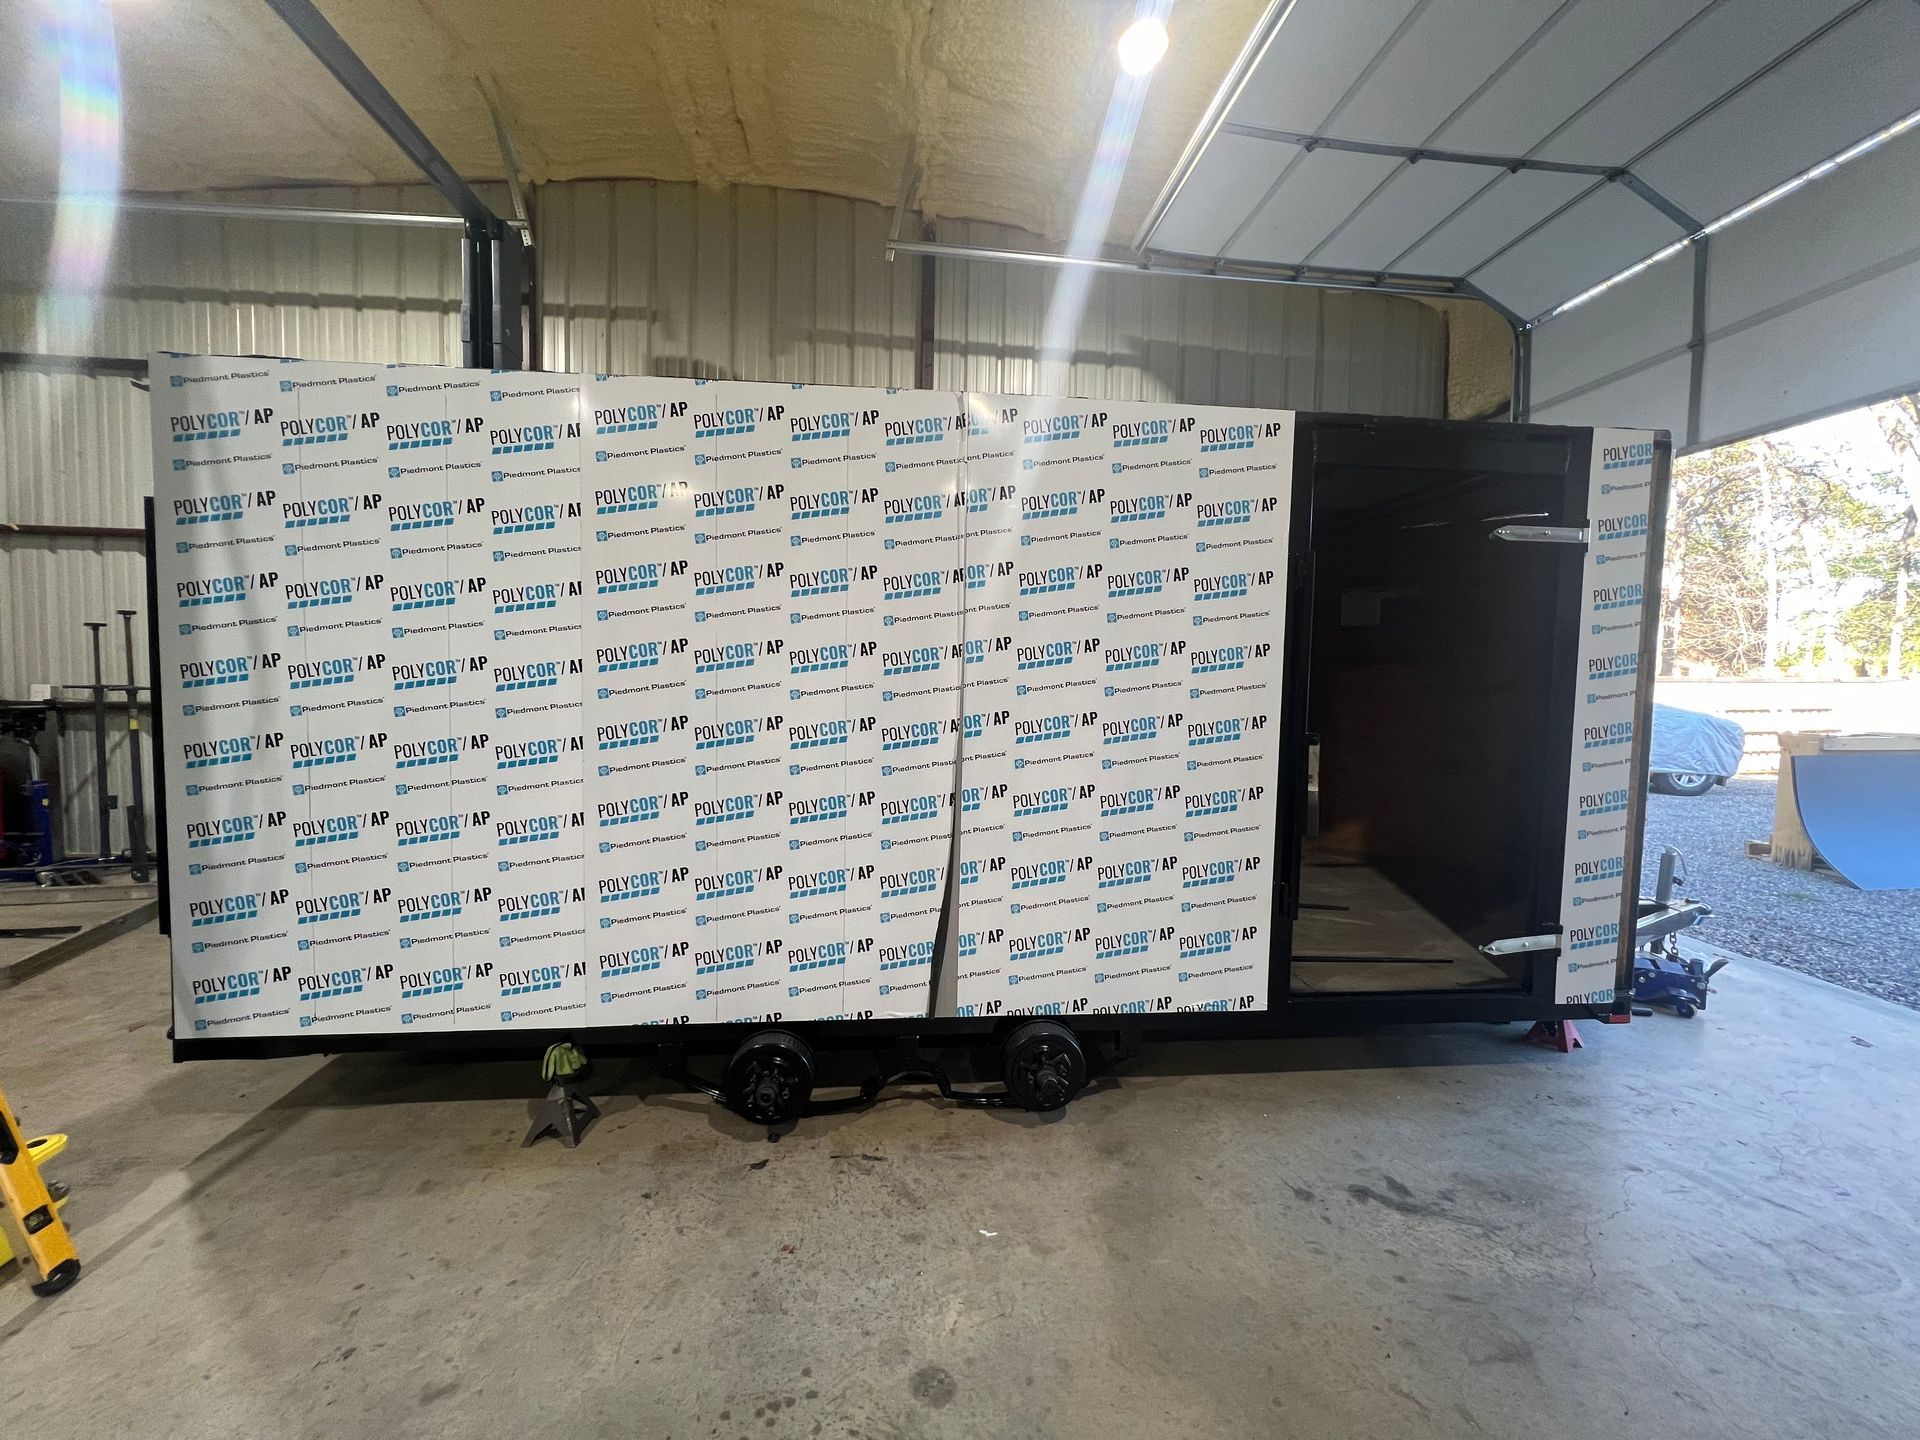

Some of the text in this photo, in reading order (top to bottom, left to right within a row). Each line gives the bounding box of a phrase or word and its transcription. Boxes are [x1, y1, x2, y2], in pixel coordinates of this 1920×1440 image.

[254, 407, 272, 425] AP
[670, 401, 687, 418] AP
[862, 409, 879, 426] AP
[1179, 417, 1194, 433] AP
[185, 456, 232, 469] Piedmont
[706, 451, 747, 463] Piedmont
[1033, 456, 1071, 468] Piedmont
[400, 464, 444, 475] Piedmont
[1209, 465, 1246, 476] Piedmont
[1089, 488, 1105, 504] AP
[466, 497, 485, 514] AP
[1261, 496, 1276, 513] AP
[608, 527, 650, 540] Piedmont
[801, 532, 842, 544] Piedmont
[297, 541, 342, 554] Piedmont
[1119, 536, 1157, 547] Piedmont
[766, 561, 784, 578] AP
[259, 571, 279, 589] AP
[706, 607, 747, 620] Piedmont
[1029, 607, 1067, 619] Piedmont
[1202, 612, 1239, 623] Piedmont
[192, 620, 238, 633] Piedmont
[404, 623, 447, 636] Piedmont
[670, 638, 689, 655] AP
[860, 641, 877, 657] AP
[1170, 640, 1186, 656] AP
[367, 653, 386, 671] AP
[609, 684, 650, 697] Piedmont
[800, 685, 840, 698] Piedmont
[1114, 683, 1151, 694] Piedmont
[302, 701, 346, 714] Piedmont
[1081, 711, 1098, 727] AP
[1251, 715, 1267, 730] AP
[471, 733, 489, 750] AP
[706, 760, 747, 774] Piedmont
[1025, 756, 1062, 768] Piedmont
[199, 779, 243, 794] Piedmont
[407, 779, 450, 793] Piedmont
[671, 791, 689, 808] AP
[766, 790, 783, 807] AP
[1109, 827, 1146, 839] Piedmont
[610, 837, 651, 851] Piedmont
[799, 835, 839, 848] Piedmont
[307, 857, 351, 871] Piedmont
[1076, 856, 1093, 872] AP
[1162, 856, 1178, 871] AP
[858, 864, 875, 881] AP
[706, 910, 746, 924] Piedmont
[204, 936, 249, 951] Piedmont
[411, 932, 453, 946] Piedmont
[375, 963, 394, 983] AP
[1104, 967, 1140, 980] Piedmont
[611, 986, 652, 1001] Piedmont
[798, 981, 837, 995] Piedmont
[312, 1010, 355, 1024] Piedmont
